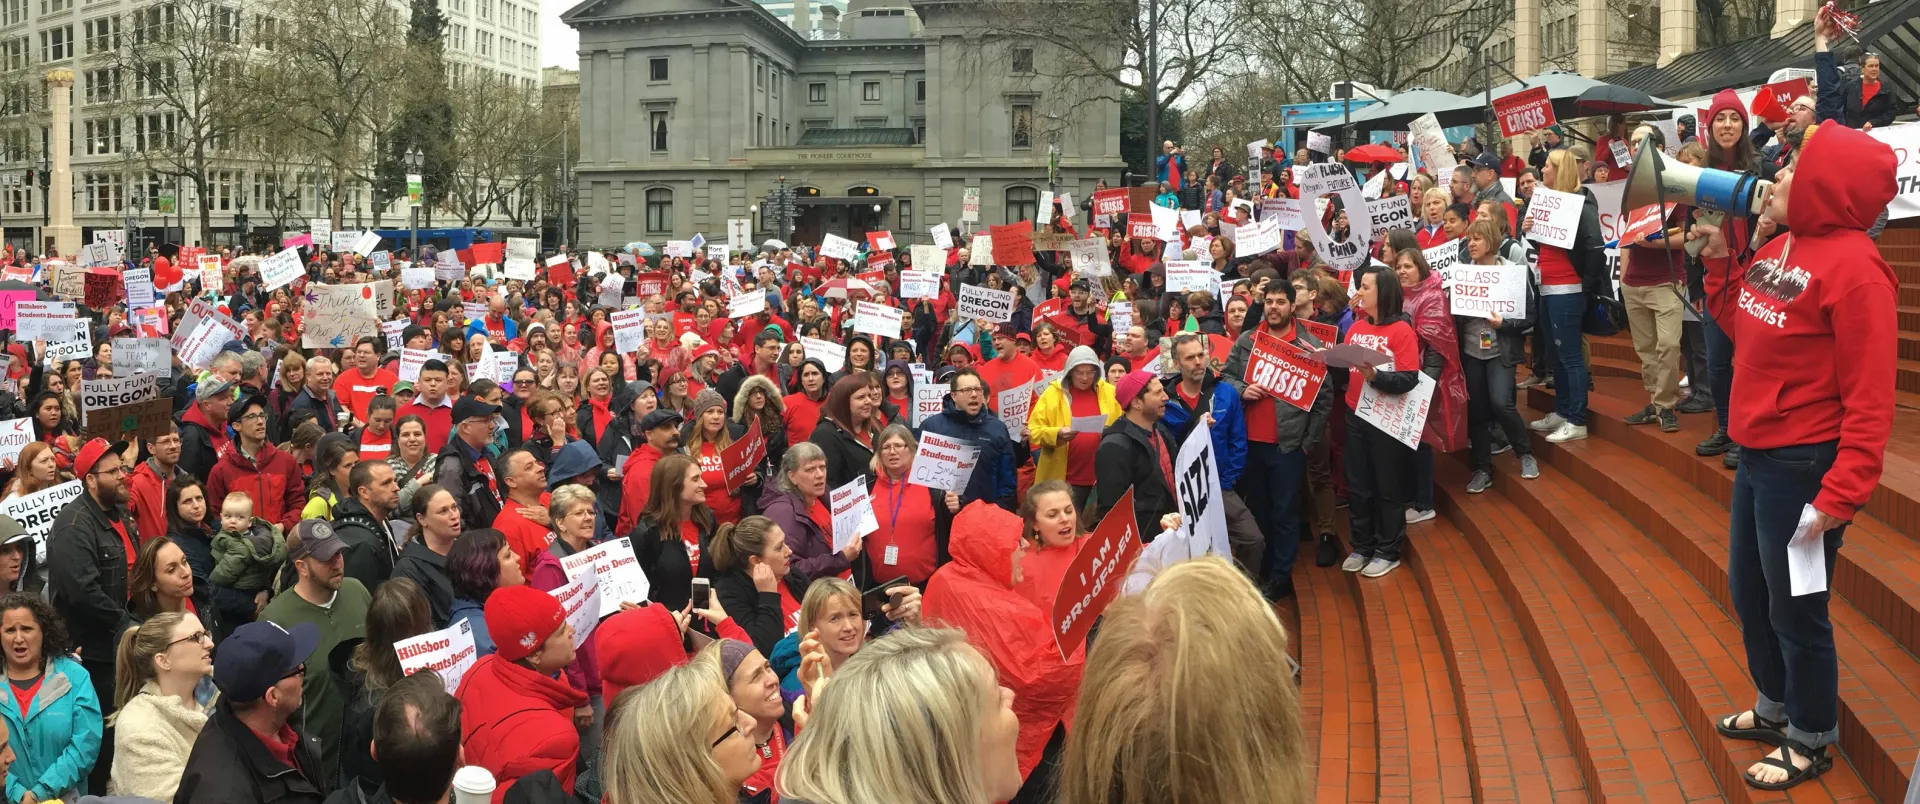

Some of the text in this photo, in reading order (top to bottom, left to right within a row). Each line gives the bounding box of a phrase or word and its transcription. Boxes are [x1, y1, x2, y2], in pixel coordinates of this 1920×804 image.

[1498, 100, 1540, 116] CLASSROOMS
[1506, 108, 1546, 133] CRISIS
[1394, 131, 1407, 145] BUR
[1320, 163, 1346, 178] FLUSH
[964, 204, 978, 212] FUTURE
[1101, 200, 1124, 214] CRISIS
[1382, 198, 1408, 210] FUND
[1532, 193, 1562, 210] CLASS
[1372, 208, 1408, 224] EGON
[1530, 208, 1551, 222] SIZE
[1133, 225, 1160, 237] CRISIS
[1531, 222, 1568, 240] COUNTS
[1328, 242, 1358, 258] FUND
[1440, 244, 1458, 256] FUND
[1081, 253, 1094, 264] OR
[1430, 257, 1457, 272] EGON
[1454, 270, 1500, 284] CLASS
[640, 284, 661, 295] CRISIS
[962, 287, 1011, 300] FULLY FUND
[1455, 284, 1489, 298] SIZE
[318, 290, 366, 310] Think
[961, 294, 1009, 310] OREGON
[1455, 298, 1515, 313] COUNTS
[192, 303, 214, 320] OUR
[332, 309, 348, 323] of
[612, 312, 639, 321] Hillsboro
[881, 313, 900, 321] Deserve
[960, 305, 1008, 319] SCHOOLS
[20, 320, 36, 332] safe
[220, 318, 243, 340] KIDS
[309, 324, 329, 339] Our
[340, 323, 372, 336] Kids
[614, 321, 638, 330] Students
[1305, 325, 1330, 336] URCES
[114, 340, 123, 350] You
[126, 340, 140, 349] can't
[1325, 342, 1334, 350] IN
[1350, 332, 1388, 345] AMERICA
[46, 343, 88, 360] CHOOLS
[125, 352, 148, 360] TEAM
[403, 350, 427, 358] Hillsboro
[1260, 336, 1319, 368] NO RESOURCES
[1253, 348, 1322, 384] CLASSROOMS IN
[84, 374, 154, 393] FULLY FUND
[1252, 360, 1307, 401] CRISIS
[84, 386, 152, 406] OREGON
[918, 390, 951, 400] CLAS
[100, 402, 154, 420] STOP
[919, 403, 944, 412] SIZ
[1004, 403, 1028, 418] SIZE
[1410, 399, 1430, 447] ALL THEM
[924, 436, 961, 450] Hillsboro
[740, 451, 744, 459] I
[920, 448, 957, 462] Students
[917, 466, 951, 491] CLASS
[8, 485, 82, 516] FULLY FUND
[832, 489, 852, 503] Hillsboro
[16, 503, 69, 530] OREG
[834, 502, 852, 516] Students
[565, 550, 607, 570] Hillsboro
[1080, 536, 1111, 586] I AM
[1060, 524, 1133, 636] #RedForEd
[566, 599, 583, 618] udents
[397, 638, 450, 660] Hillsboro
[451, 645, 475, 666] Deserve
